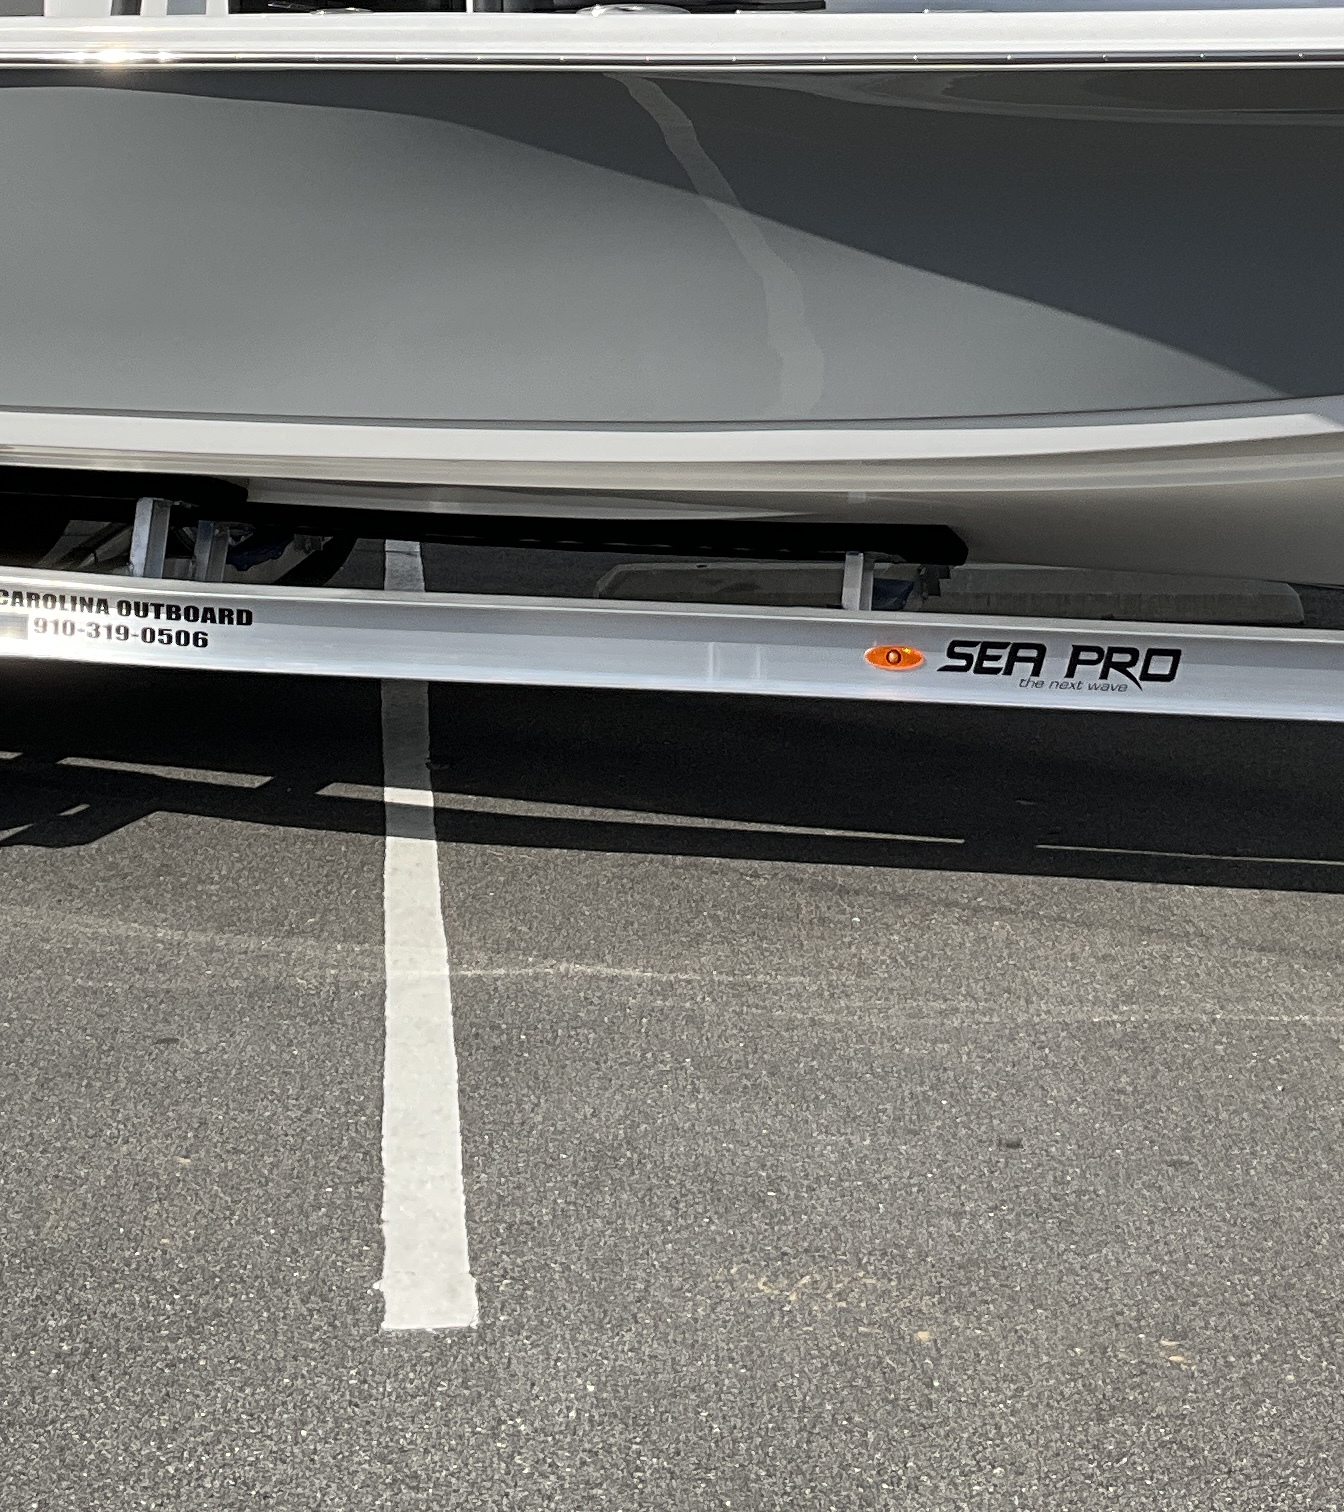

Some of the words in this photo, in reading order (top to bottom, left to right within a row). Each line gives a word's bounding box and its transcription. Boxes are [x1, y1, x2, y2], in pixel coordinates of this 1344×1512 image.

[116, 599, 254, 626] OUTBOARD
[33, 617, 209, 648] 910-319-0506
[937, 640, 1047, 677] SEA
[1064, 644, 1182, 691] PRO
[1018, 678, 1045, 689] the
[1048, 679, 1083, 691] next
[1087, 681, 1128, 693] wave
